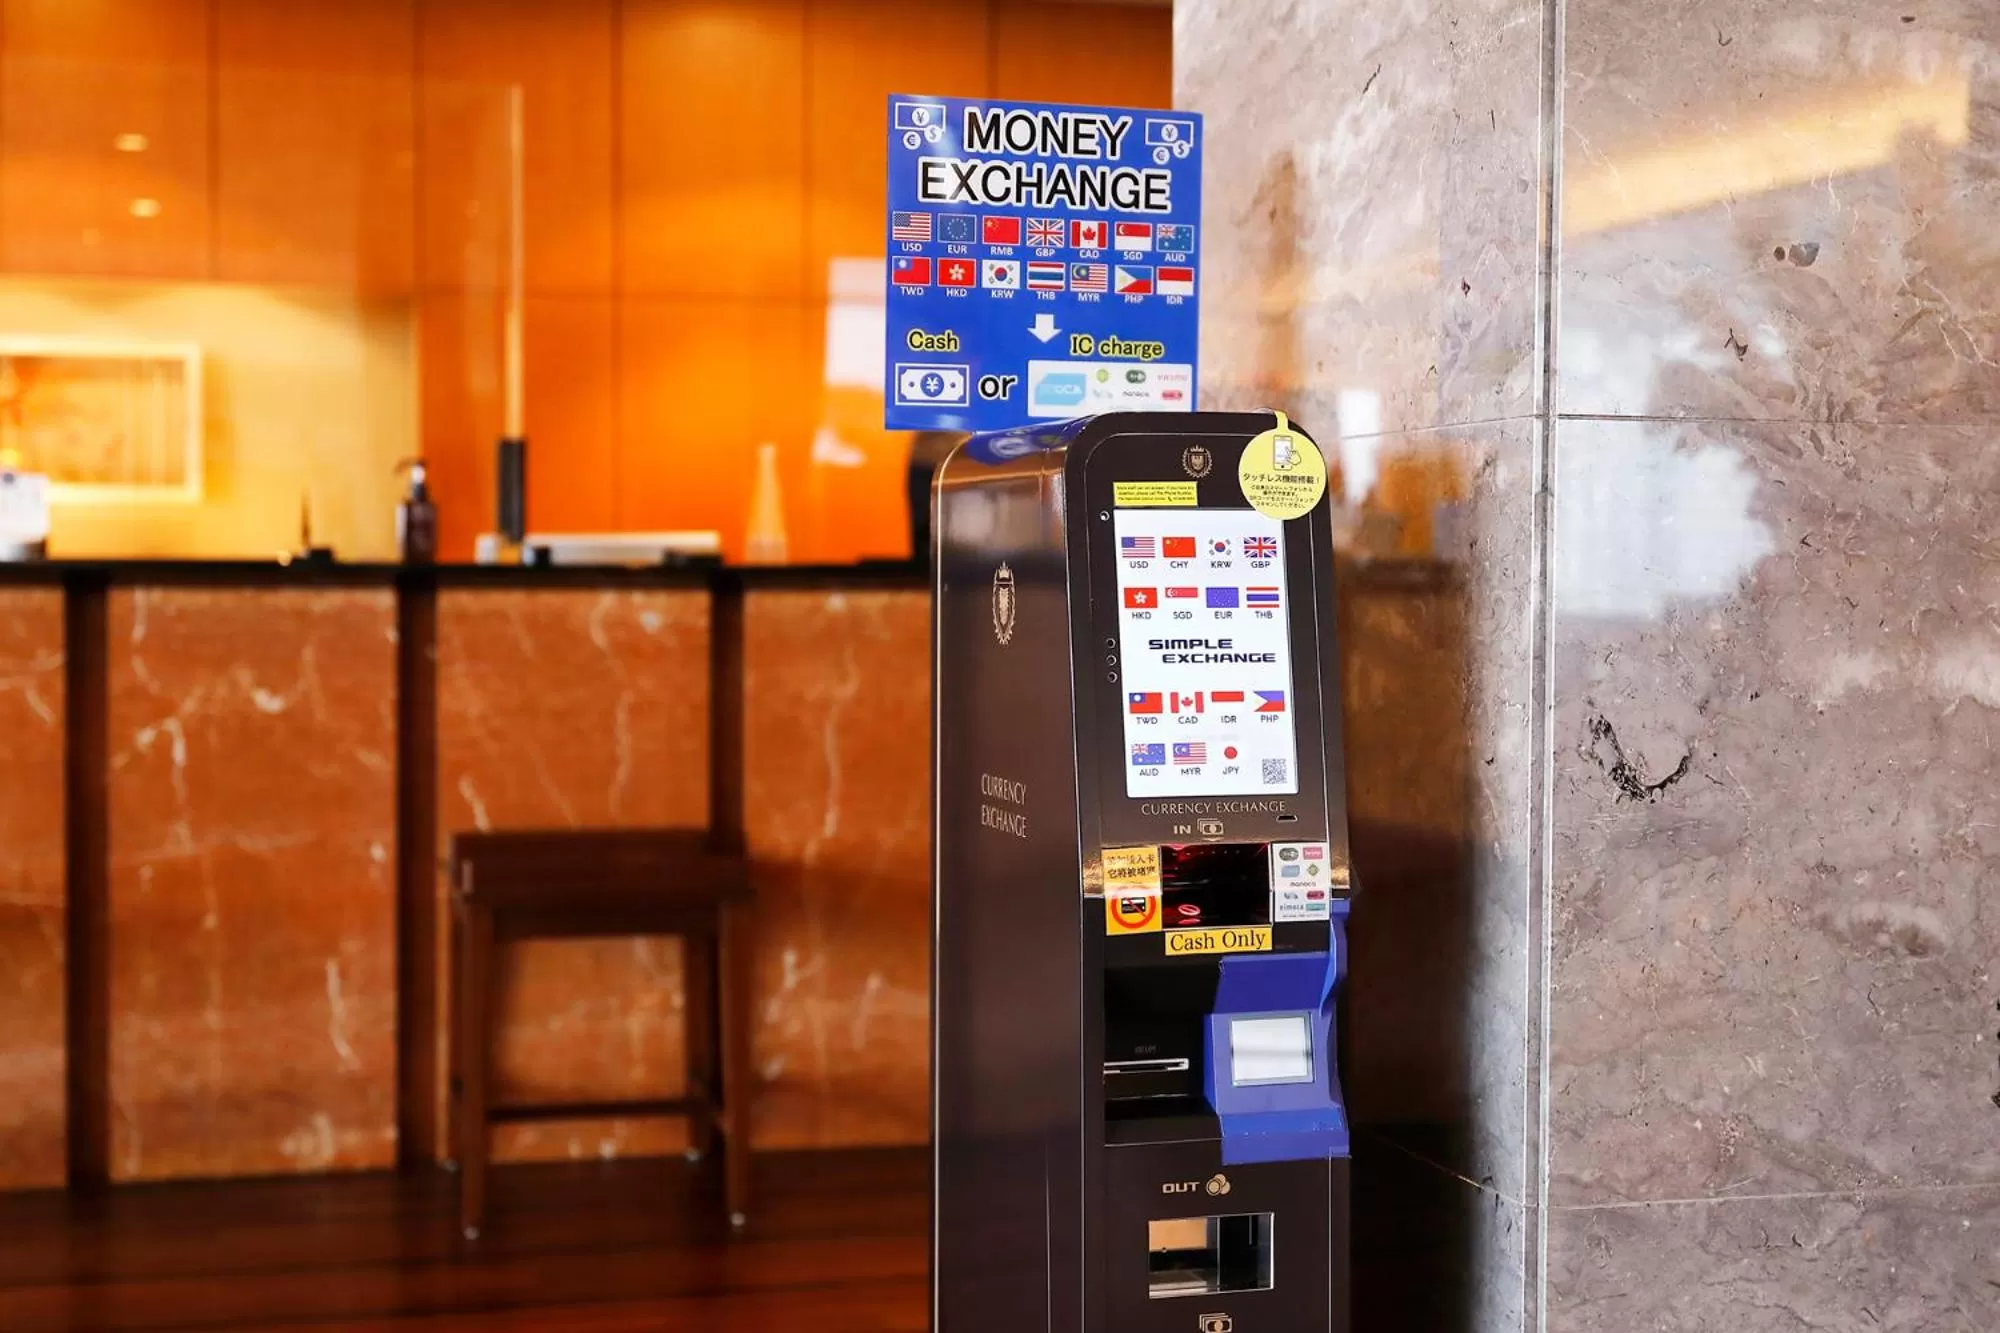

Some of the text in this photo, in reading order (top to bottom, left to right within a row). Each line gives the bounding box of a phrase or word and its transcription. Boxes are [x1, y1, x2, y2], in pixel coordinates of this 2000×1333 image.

[967, 111, 1129, 157] MONEY
[921, 161, 1169, 210] EXCHANGE
[902, 242, 1186, 263] USD EUR RMB GBP CAD SGD AUD
[900, 286, 1183, 305] TWD HKD KRW THB MYR PHP IDR
[908, 330, 959, 351] Cash
[1071, 336, 1164, 359] IC charge
[979, 374, 1017, 399] or
[1130, 560, 1271, 569] USD CHY KRW GBP
[1132, 610, 1273, 620] HKD SGD EUR THB
[1148, 638, 1233, 650] SIMPLE
[1162, 652, 1276, 664] EXCHANGE
[1136, 714, 1279, 725] TWD CAD IDR PHP
[1139, 766, 1239, 777] AUD MYR JPY
[981, 773, 1026, 805] CURRENCY
[1141, 800, 1287, 815] CURRENCY EXCHANGE
[981, 804, 1027, 838] EXCHANGE
[1173, 825, 1192, 835] IN
[1170, 930, 1266, 952] Cash Only
[1162, 1181, 1201, 1194] OUT
